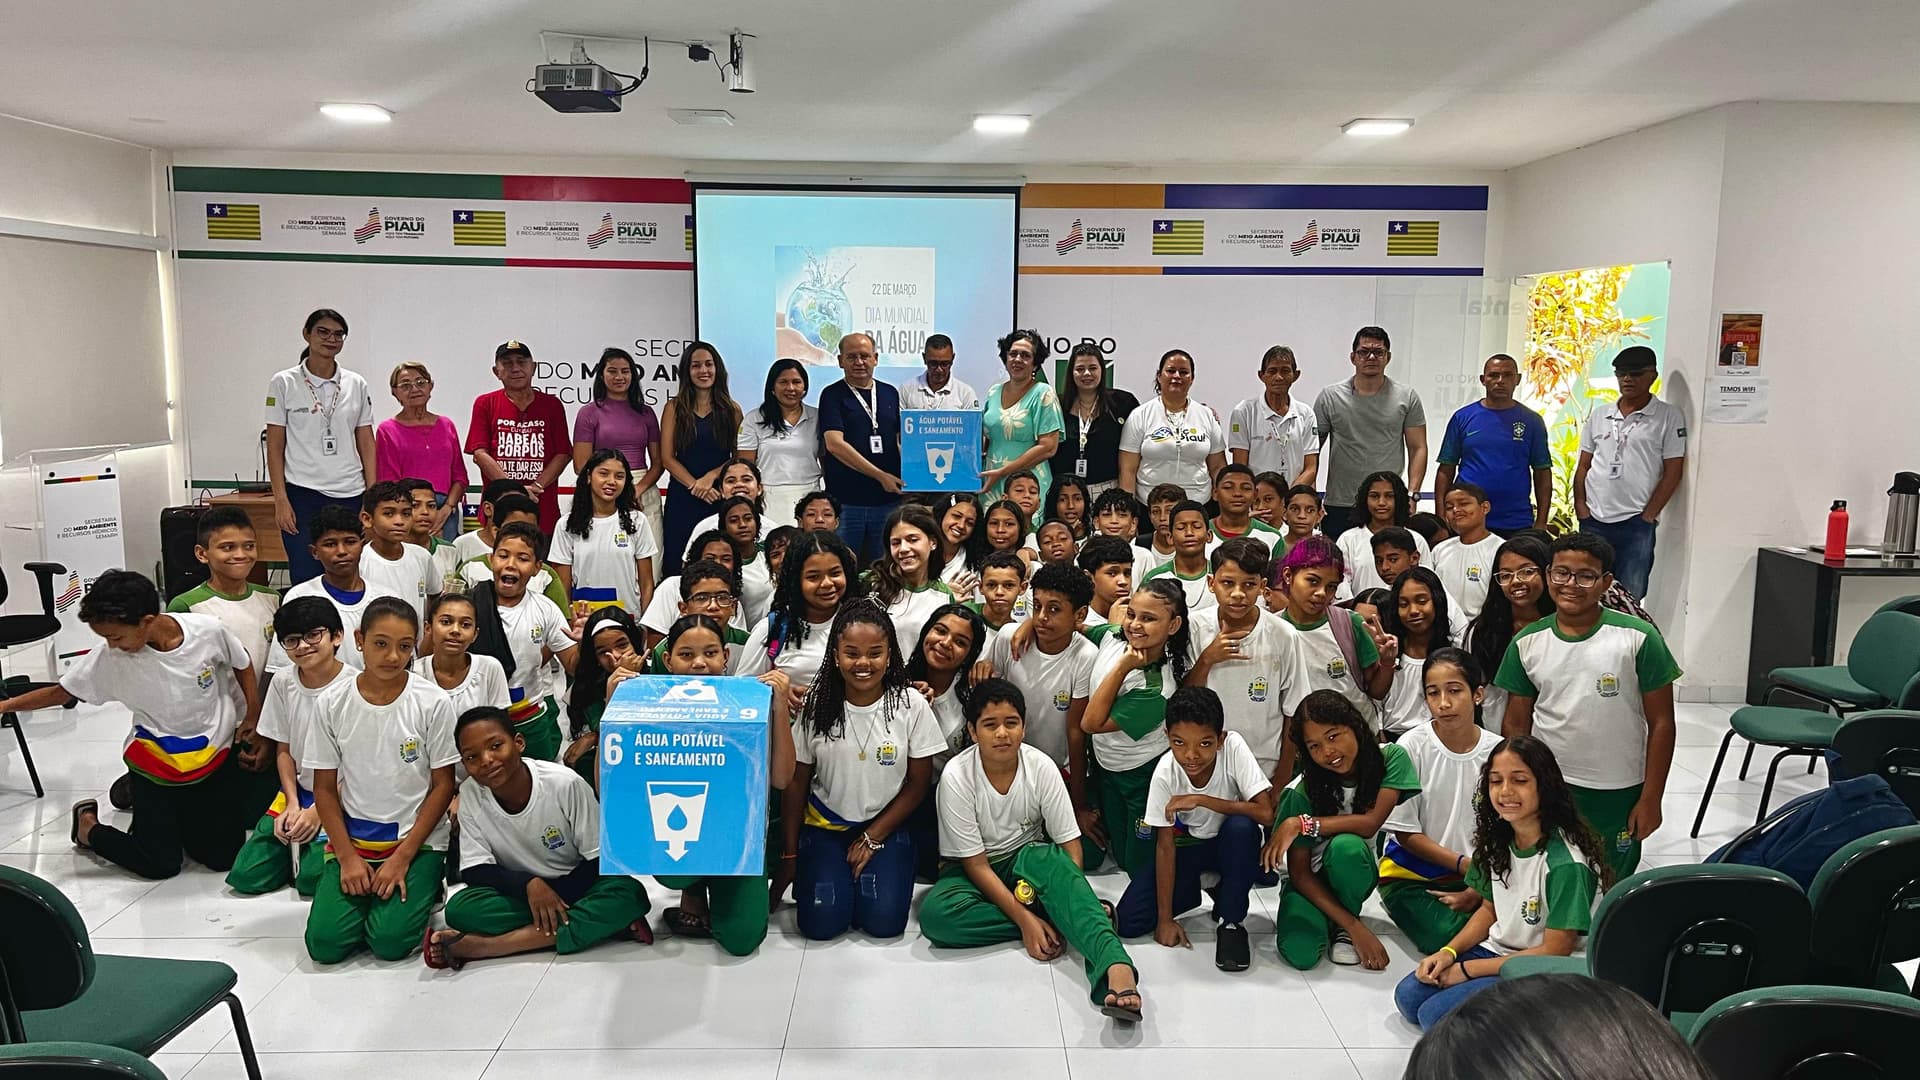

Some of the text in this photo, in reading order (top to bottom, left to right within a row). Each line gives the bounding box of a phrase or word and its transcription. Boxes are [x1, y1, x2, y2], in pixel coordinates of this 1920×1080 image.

[385, 221, 424, 232] PIAUÍ
[617, 226, 657, 237] PIAUÍ
[1086, 232, 1125, 242] PIAUÍ
[1321, 232, 1360, 243] PIAUÍ
[872, 283, 917, 298] 22 DE MARÇO
[865, 306, 928, 325] DIA MUNDIAL
[888, 325, 926, 354] ÁGUA
[538, 362, 573, 380] DO
[497, 418, 545, 428] POR ACASO
[904, 417, 914, 434] 6
[919, 415, 963, 425] ÁGUA POTÁVEL
[919, 426, 964, 434] E SANEAMENTO
[498, 432, 544, 446] HABEAS
[497, 444, 544, 458] CORPUS
[508, 461, 516, 471] TE
[516, 461, 529, 472] DAR
[530, 461, 544, 472] ESSA
[89, 522, 117, 530] AMBIENTE
[62, 530, 91, 538] RECURSOS
[739, 707, 758, 720] 6
[634, 730, 726, 748] ÁGUA POTÁVEL
[604, 733, 624, 766] 6
[635, 752, 726, 767] E SANEAMENTO
